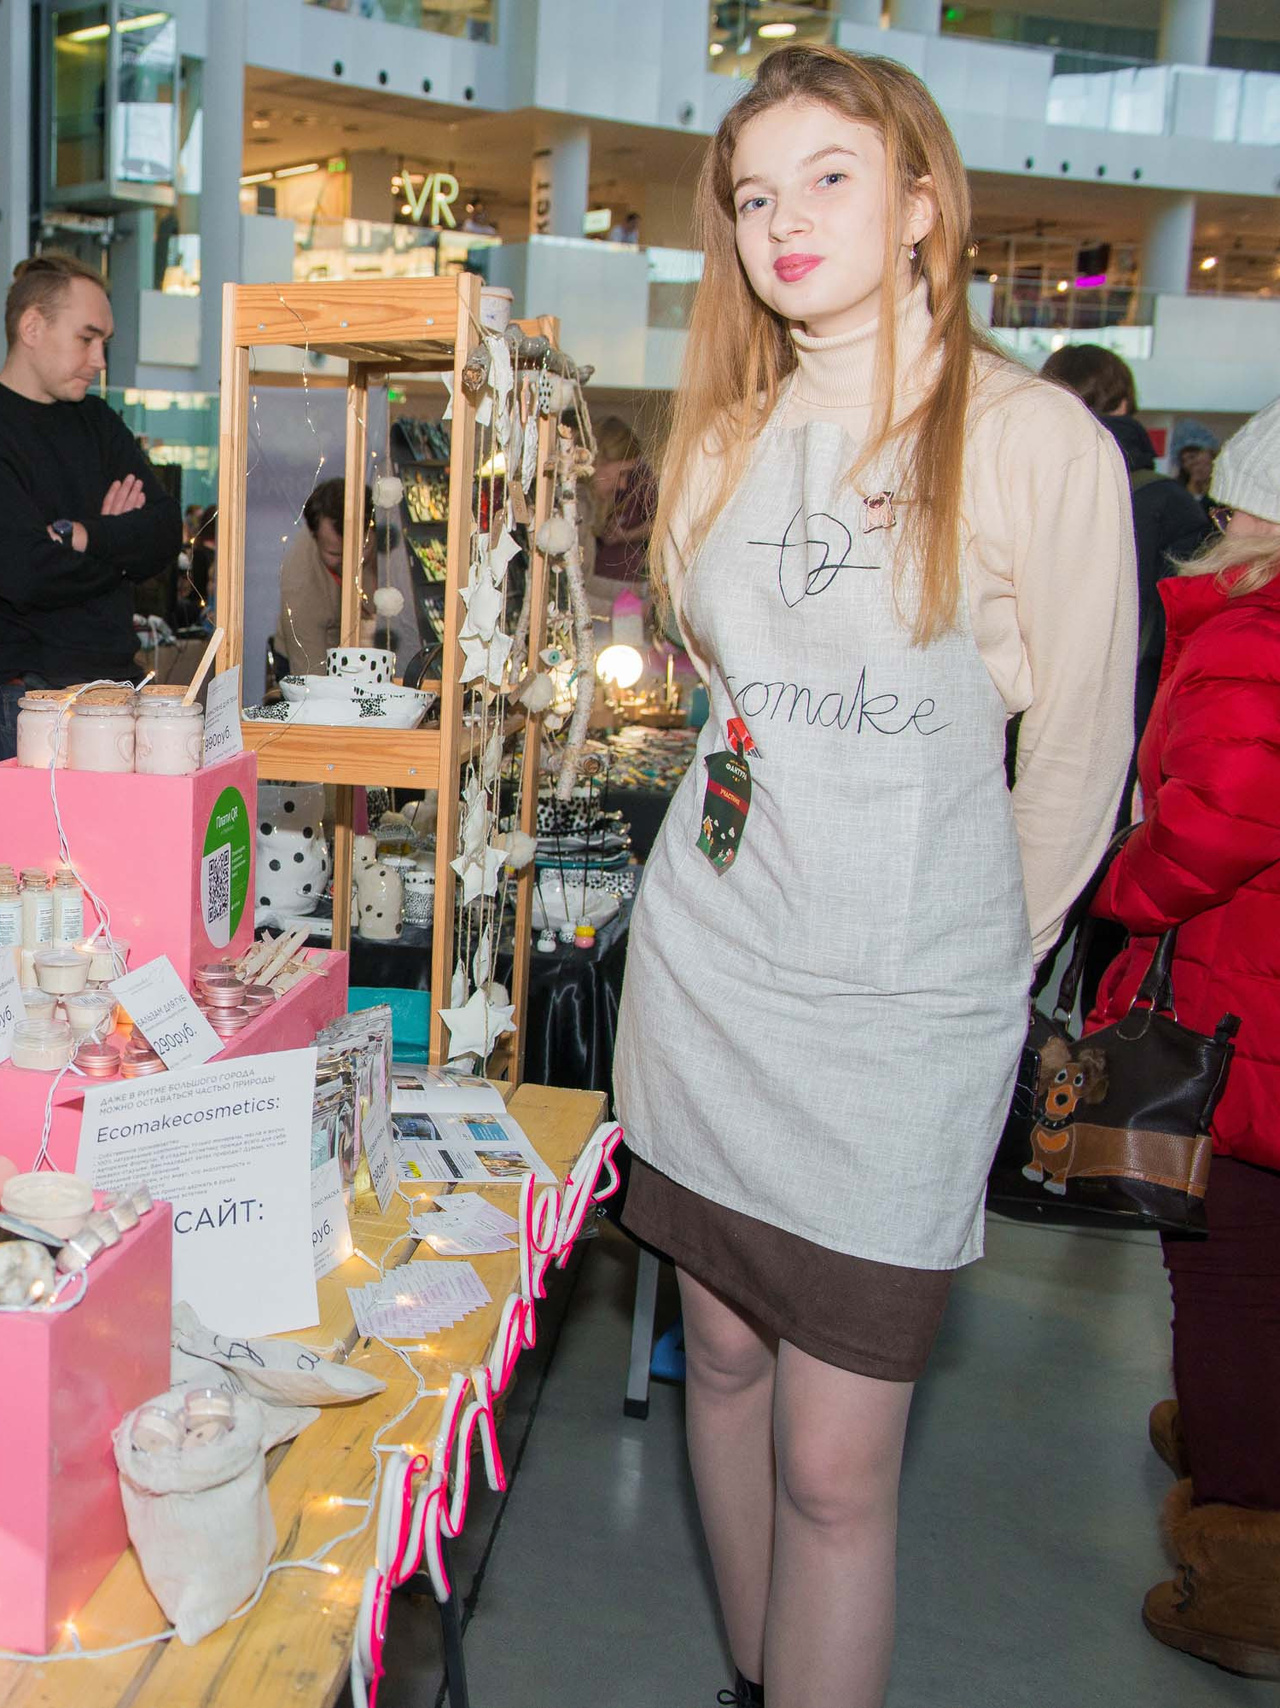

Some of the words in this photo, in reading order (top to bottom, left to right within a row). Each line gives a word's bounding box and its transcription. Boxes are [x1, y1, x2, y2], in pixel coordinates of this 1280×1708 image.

[401, 169, 459, 229] VR
[153, 1023, 197, 1055] 290руб.
[99, 1102, 134, 1116] МОЖНО
[136, 1090, 194, 1110] ОСТАВАТЬСЯ
[195, 1082, 231, 1098] ЧАСТЬЮ
[100, 1093, 127, 1106] ДАЖЕ
[129, 1091, 135, 1100] В
[137, 1085, 167, 1099] РИТМЕ
[169, 1075, 217, 1092] БОЛЬШОГО
[219, 1069, 255, 1083] ГОРОДА
[97, 1096, 280, 1143] Ecomakecosmetics:
[174, 1198, 263, 1234] САЙТ:
